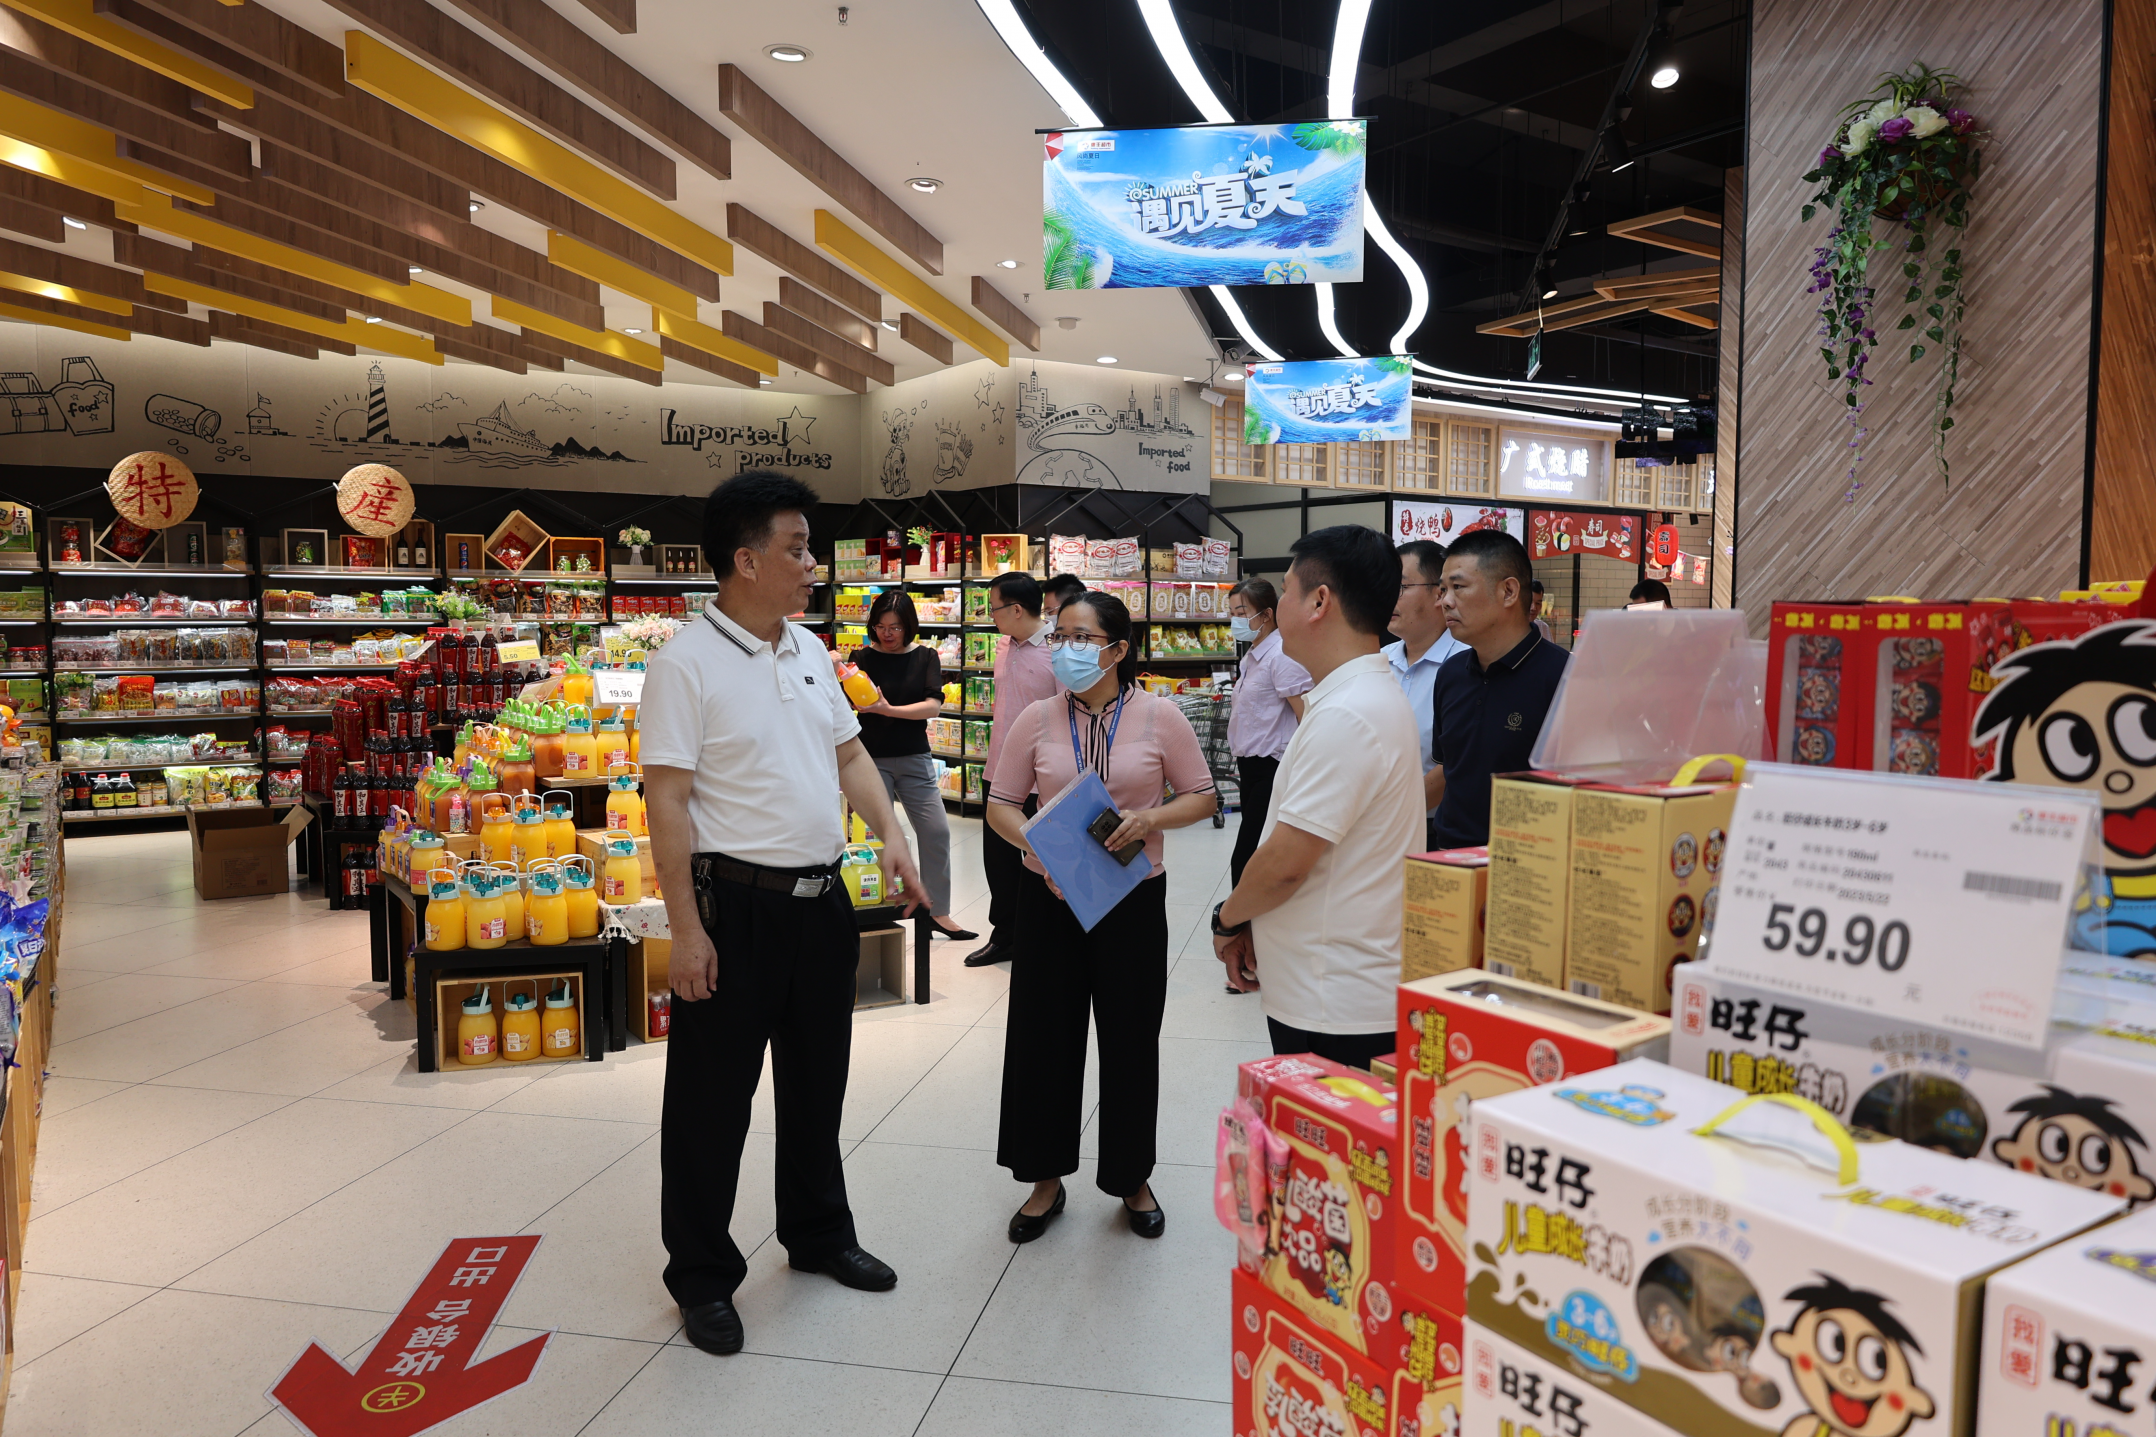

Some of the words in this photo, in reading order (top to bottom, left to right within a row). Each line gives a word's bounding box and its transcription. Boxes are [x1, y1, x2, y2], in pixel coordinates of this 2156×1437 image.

[1130, 168, 1309, 240] 遇见夏天
[67, 400, 100, 418] food
[1290, 381, 1383, 420] 遇见夏天
[660, 407, 790, 452] Imported
[734, 446, 832, 475] products
[1138, 442, 1186, 460] Imported
[1166, 461, 1191, 474] food
[1499, 439, 1590, 478] 广式烧腊
[122, 462, 187, 520] 特
[1415, 513, 1441, 538] 烧鸭
[1586, 517, 1603, 535] 寿司
[609, 689, 633, 698] 19.90
[1762, 902, 1912, 973] 59.90
[1904, 984, 1922, 1002] 元
[1710, 996, 1810, 1052] 旺仔
[1294, 1116, 1330, 1151] 旺旺
[1413, 1115, 1433, 1179] 旺旺
[1505, 1140, 1595, 1209] 旺仔
[1497, 1198, 1634, 1287] 儿童成长牛奶
[1288, 1335, 1326, 1376] 旺旺
[2053, 1329, 2156, 1414] 旺
[1498, 1356, 1591, 1437] 旺仔
